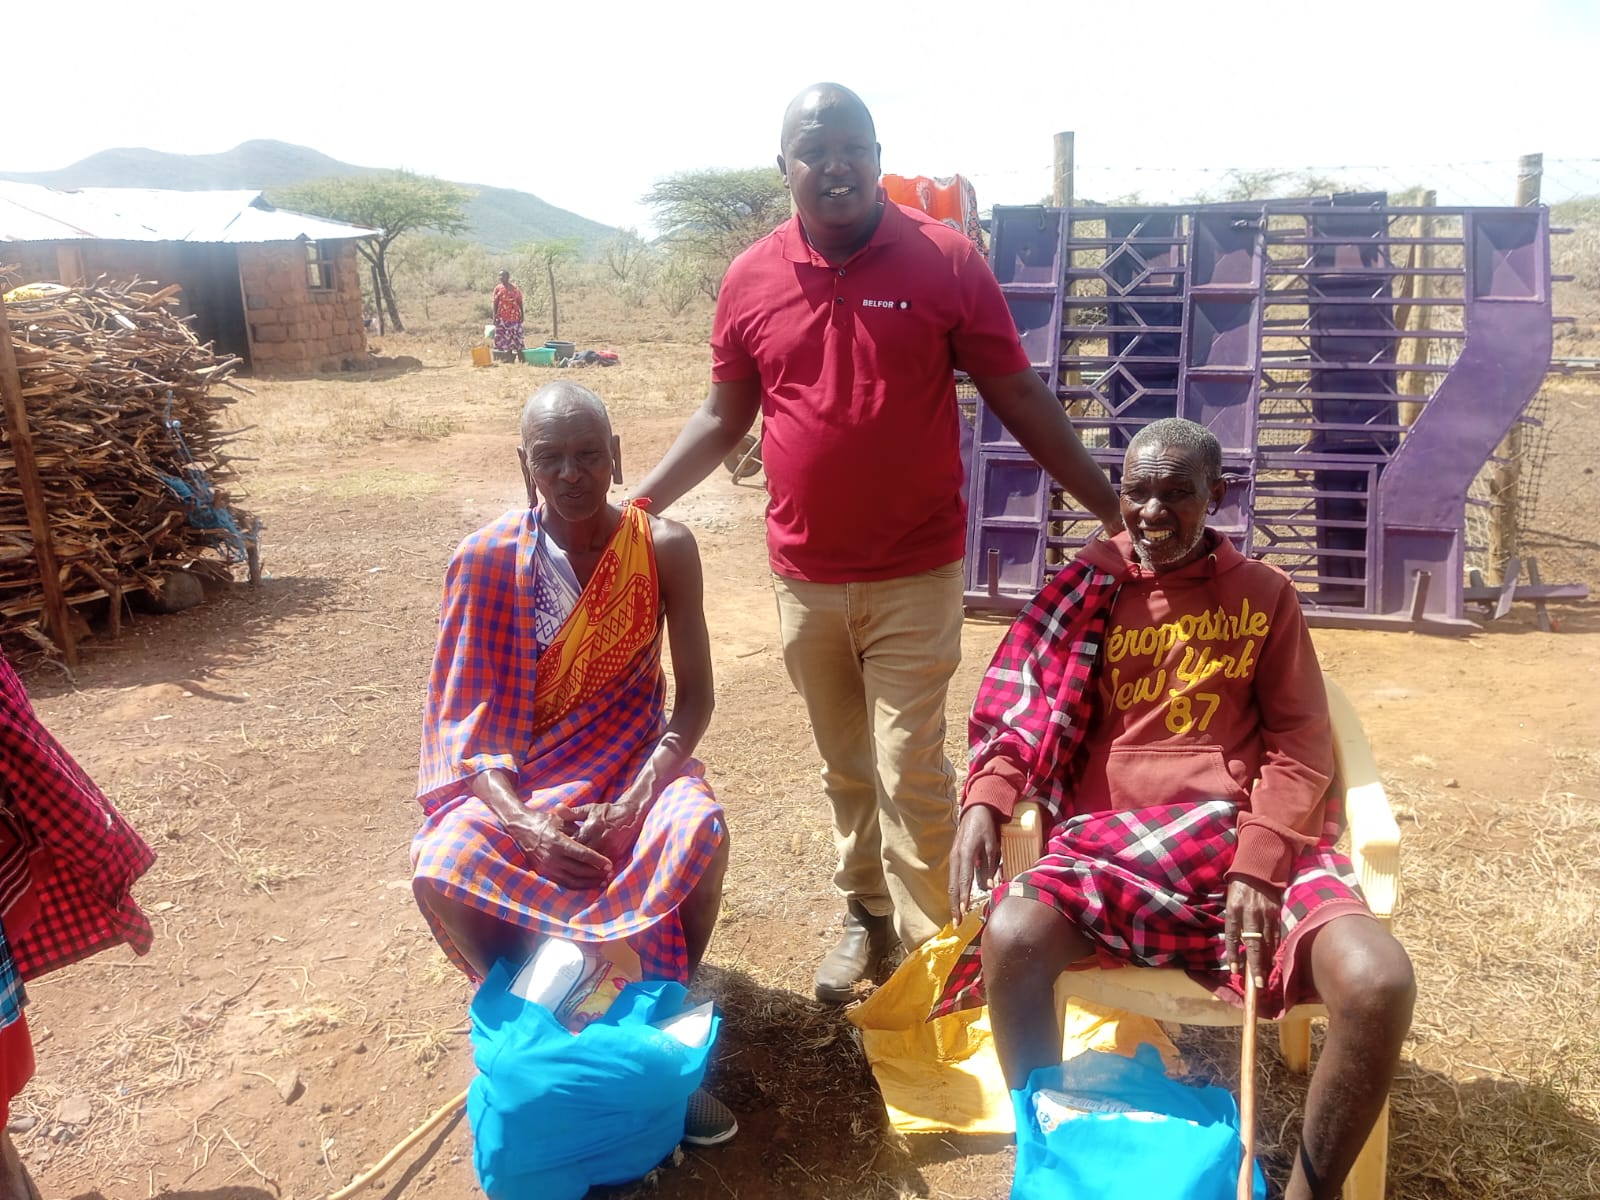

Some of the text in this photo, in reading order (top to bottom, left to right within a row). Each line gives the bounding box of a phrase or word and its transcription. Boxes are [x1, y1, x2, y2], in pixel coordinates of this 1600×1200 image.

[862, 299, 895, 309] BELFOR
[1168, 639, 1255, 698] York
[1164, 692, 1221, 734] 87
